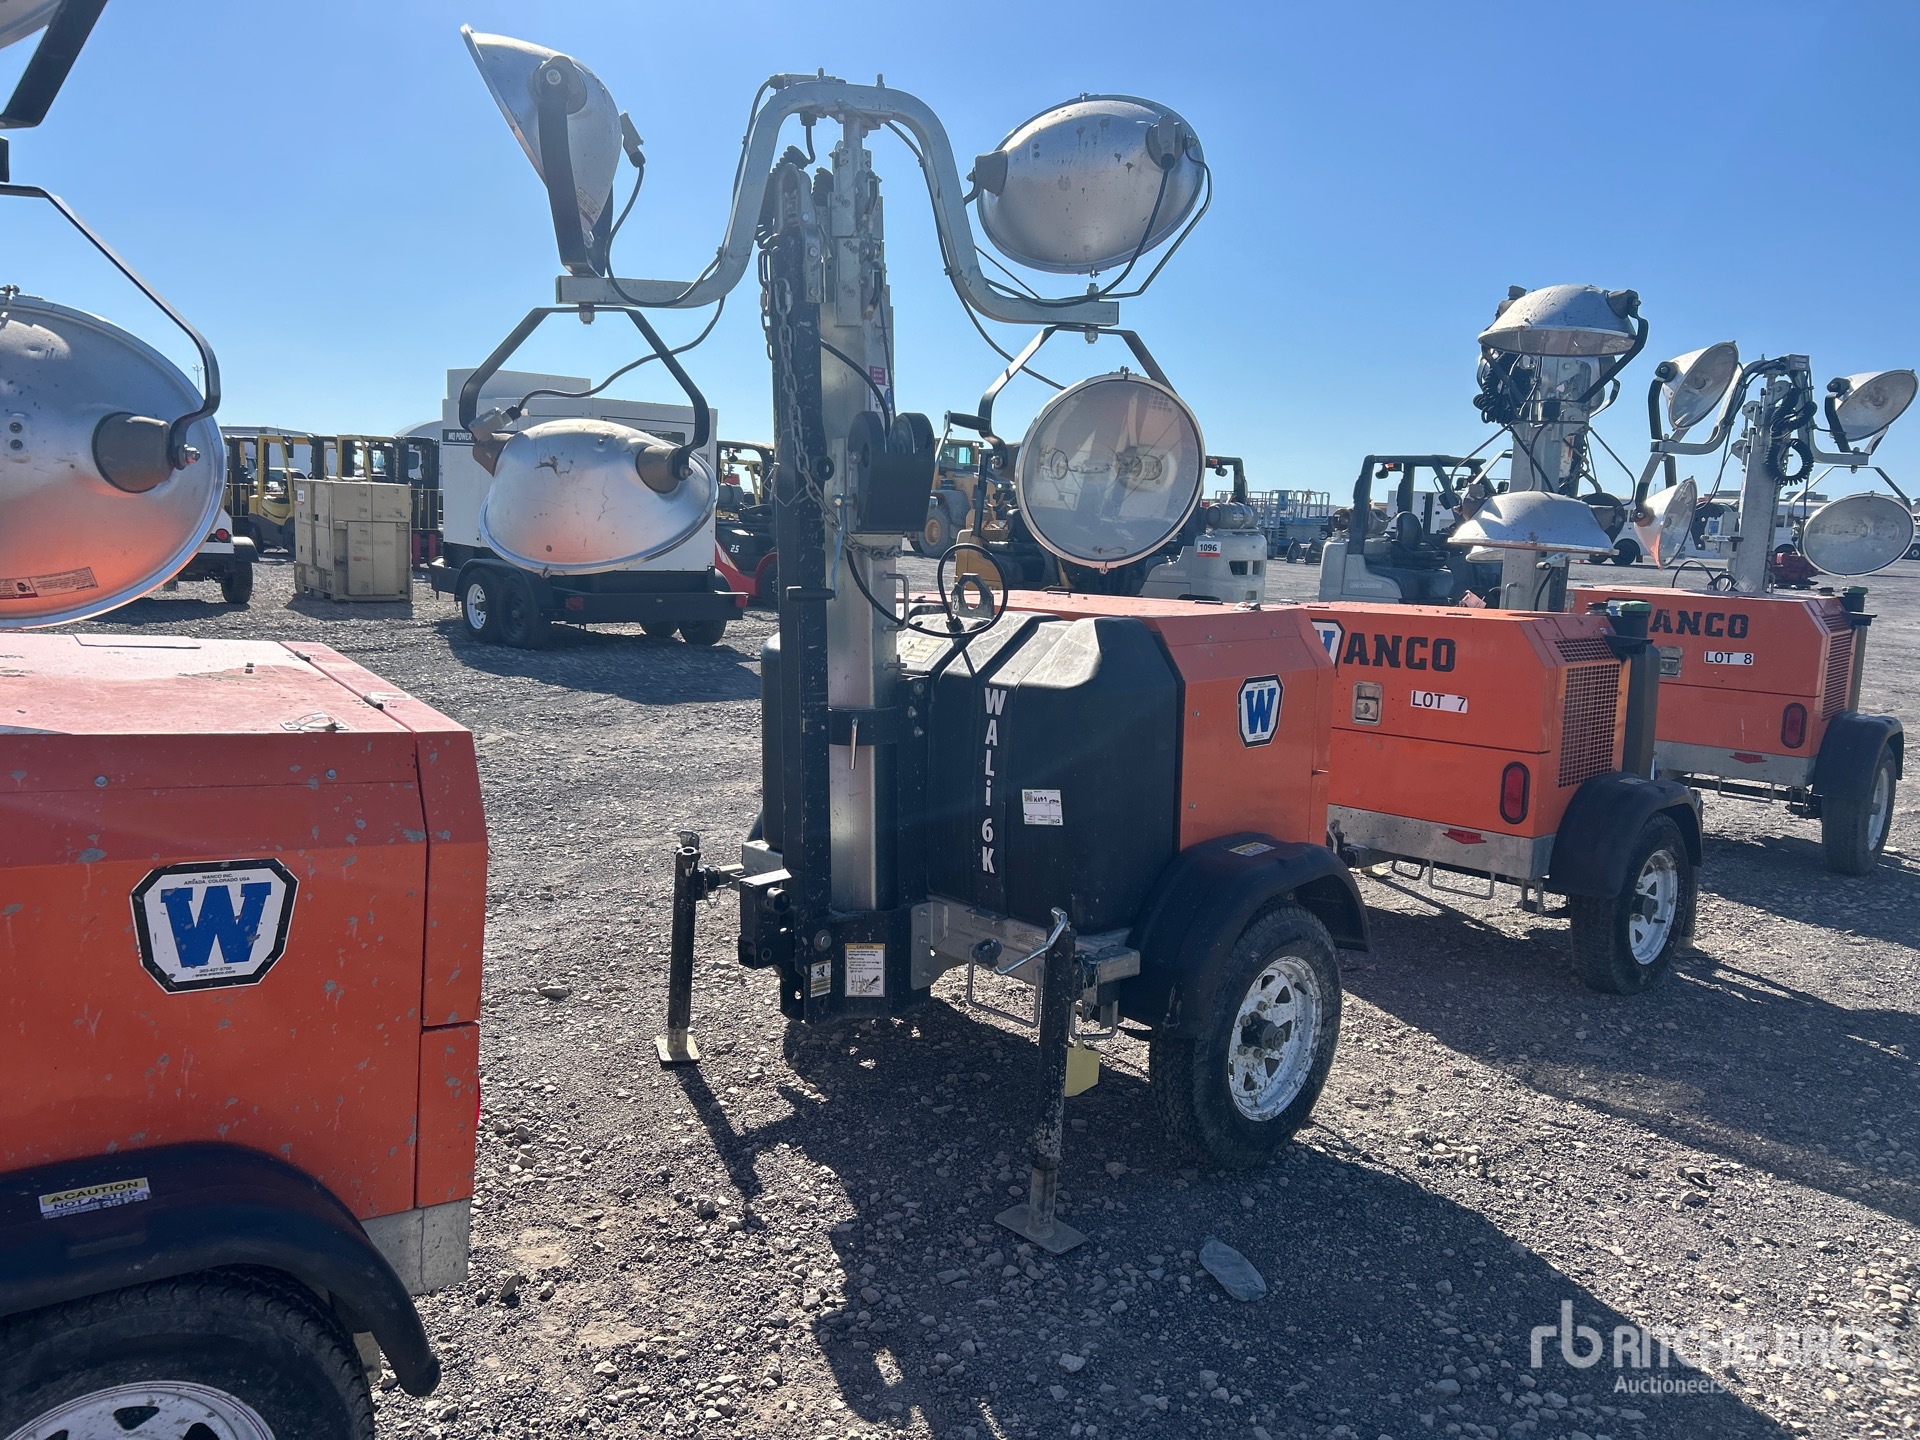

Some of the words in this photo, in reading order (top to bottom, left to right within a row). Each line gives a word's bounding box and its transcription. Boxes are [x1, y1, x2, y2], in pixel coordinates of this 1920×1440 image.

[456, 432, 472, 441] POWER
[1199, 543, 1218, 552] 1096
[1610, 605, 1749, 639] ANCO
[1705, 651, 1734, 664] LOT
[1743, 653, 1753, 665] 8
[1245, 688, 1276, 734] W
[1412, 690, 1446, 709] LOT
[1457, 696, 1467, 712] 7
[160, 881, 272, 968] W
[54, 1198, 83, 1210] NOT
[87, 1196, 100, 1204] A
[101, 1189, 138, 1201] STEP
[64, 1181, 138, 1200] CAUTION
[102, 1198, 122, 1209] 35
[123, 1193, 149, 1204] PSI
